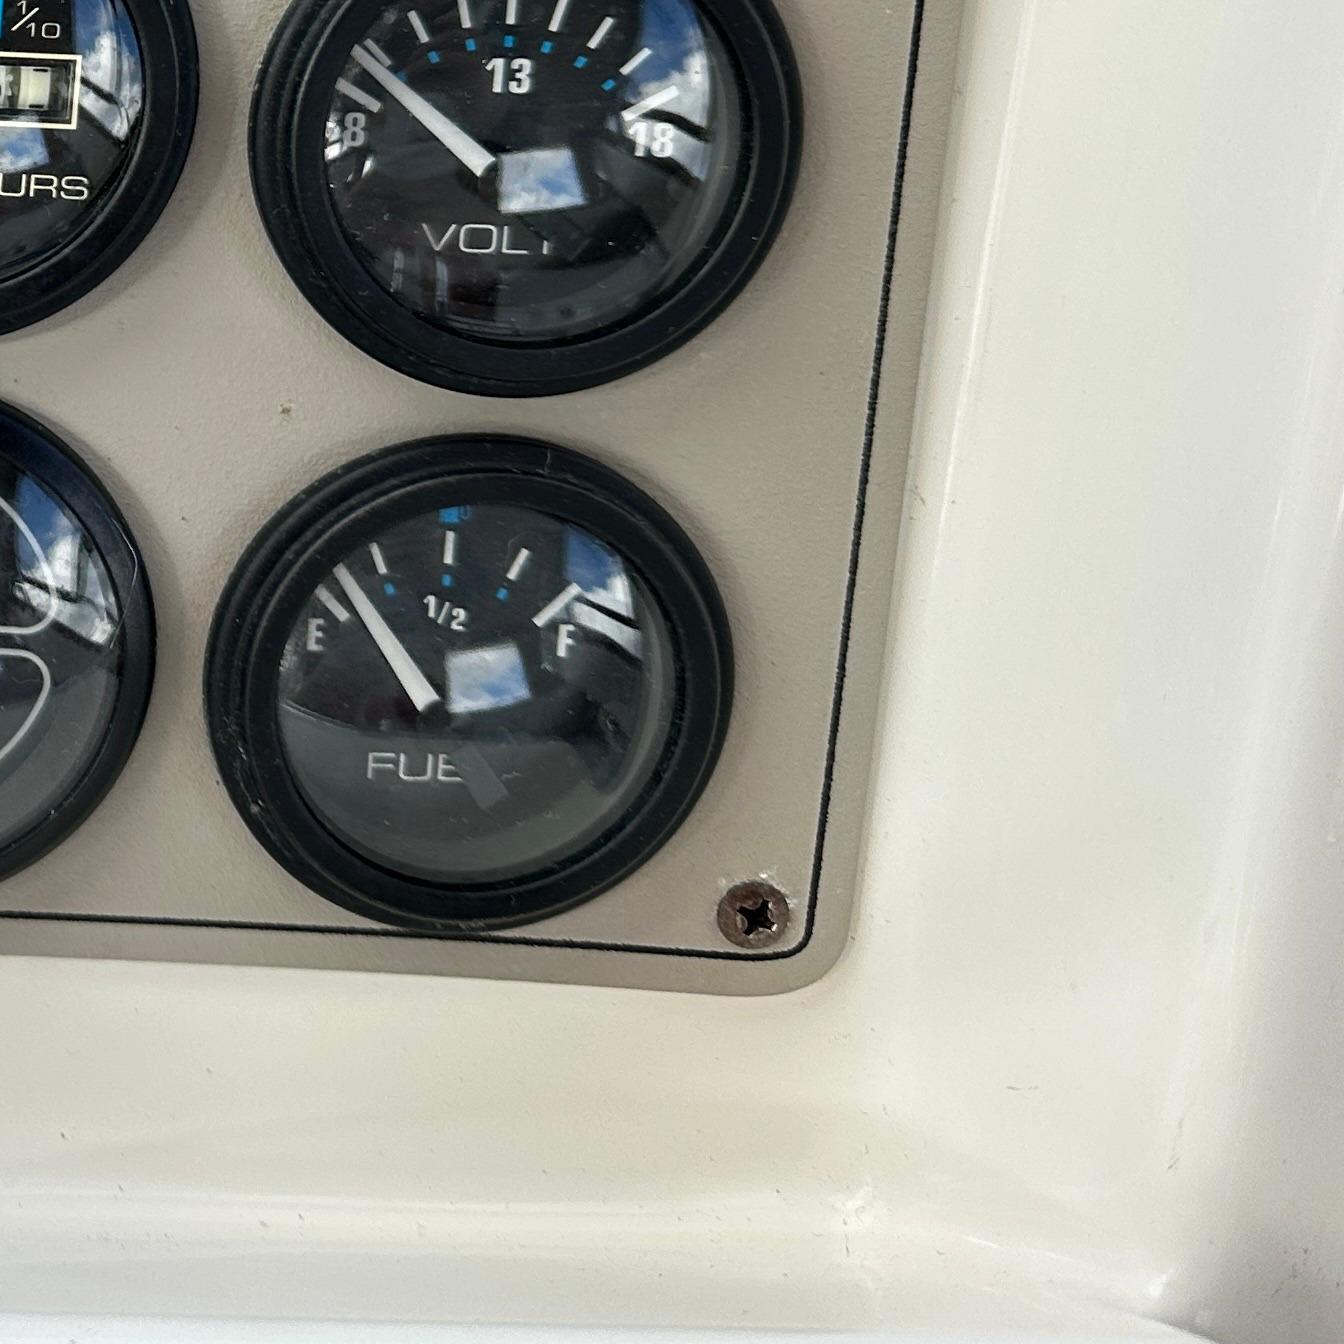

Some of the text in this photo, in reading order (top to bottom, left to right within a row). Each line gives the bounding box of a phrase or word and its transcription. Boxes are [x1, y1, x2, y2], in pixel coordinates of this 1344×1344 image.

[485, 58, 533, 94] 13
[343, 112, 367, 146] 8
[628, 122, 674, 157] 18
[423, 595, 468, 631] 1/2
[306, 618, 325, 651] E
[556, 623, 575, 657] F
[367, 752, 463, 781] FUE
